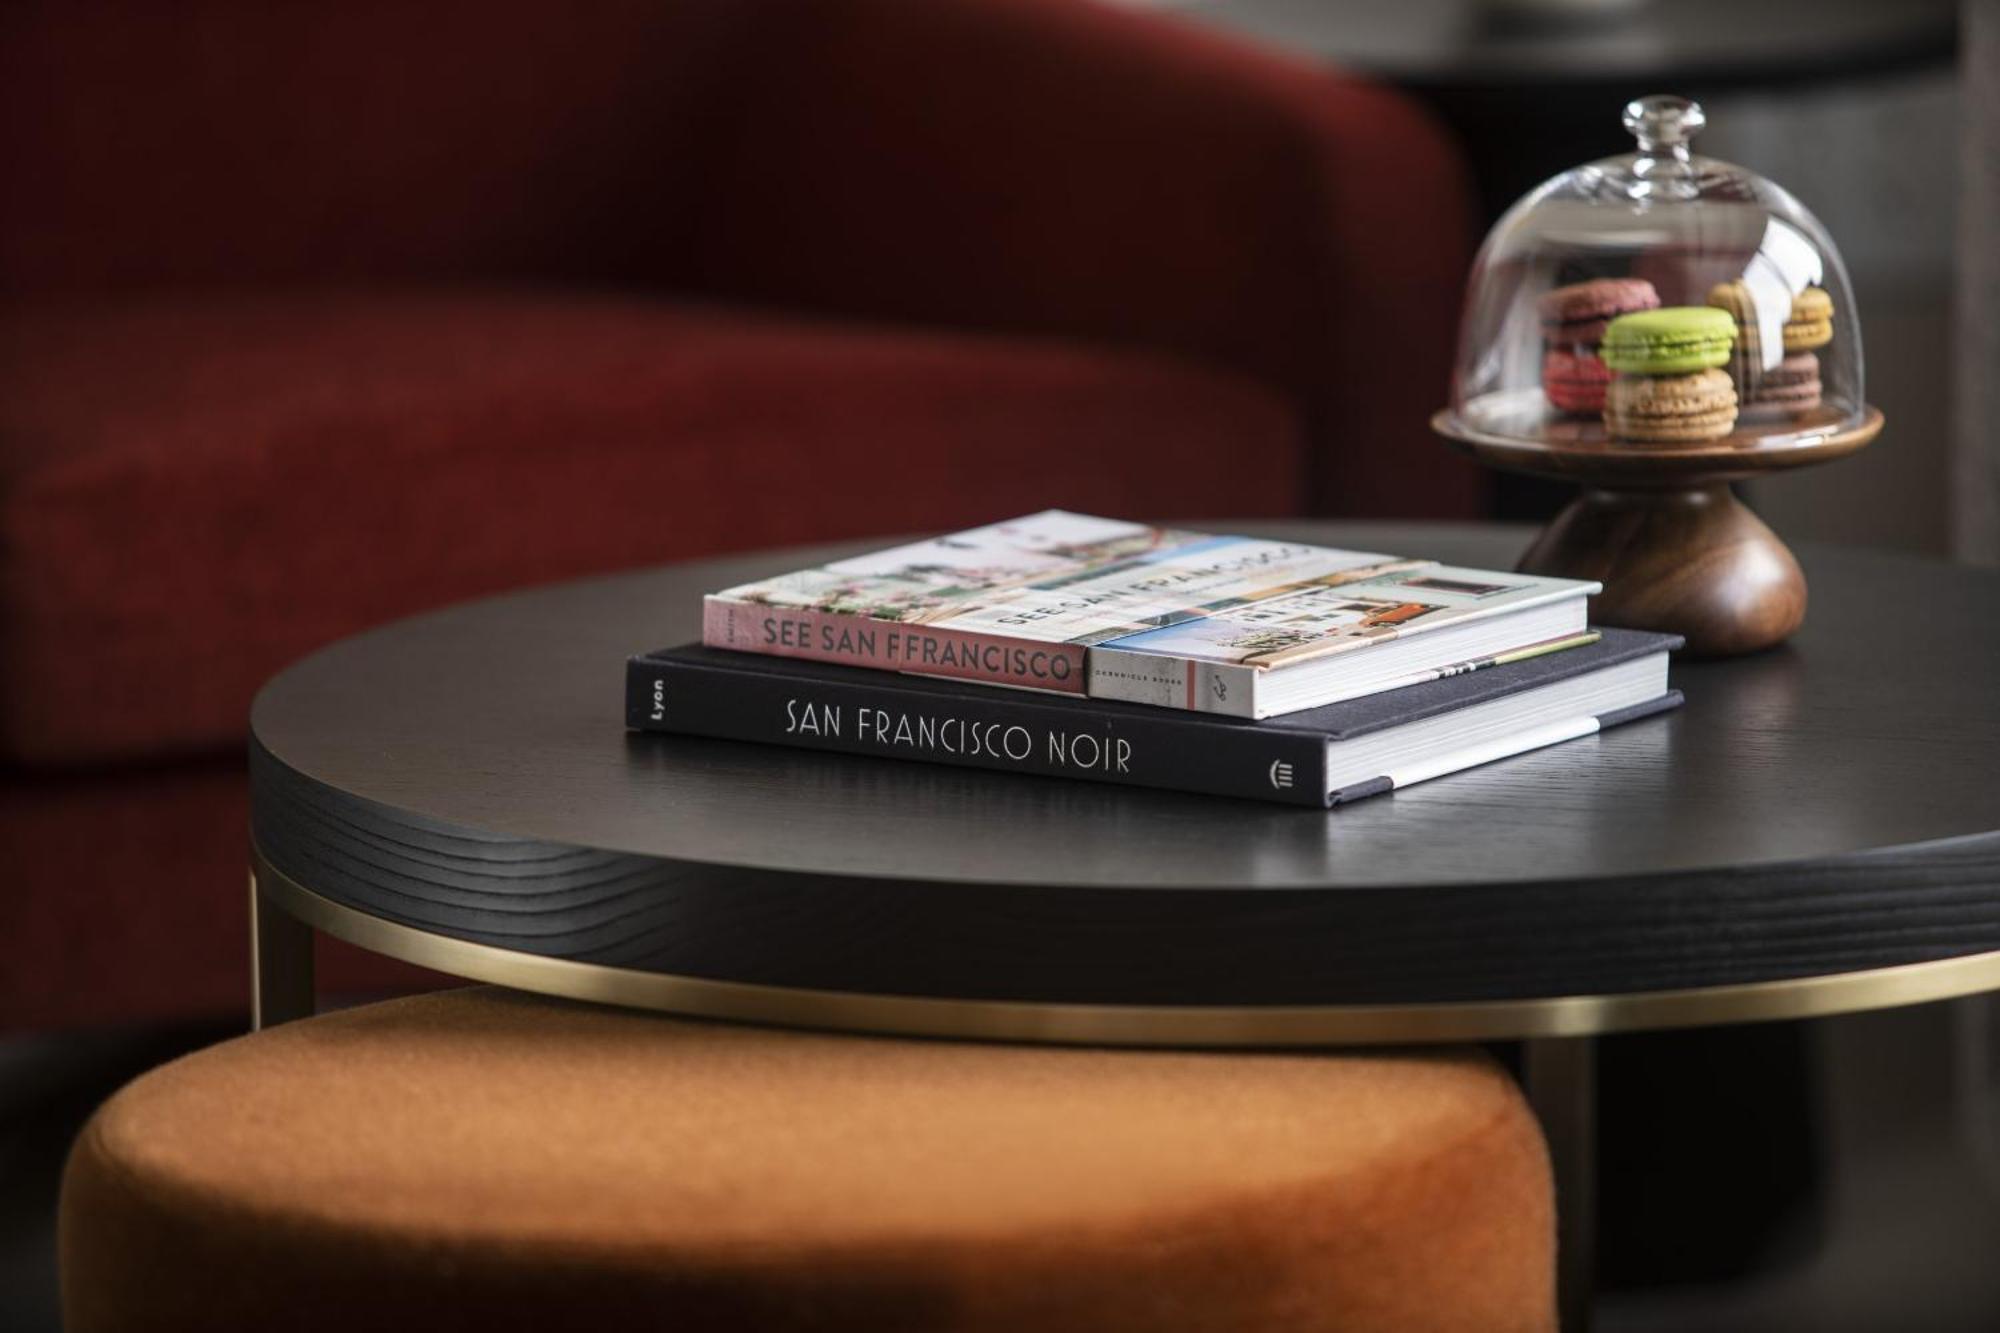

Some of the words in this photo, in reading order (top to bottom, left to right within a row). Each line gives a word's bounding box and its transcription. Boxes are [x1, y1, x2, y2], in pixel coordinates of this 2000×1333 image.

[995, 606, 1066, 625] SEE
[763, 617, 812, 649] SEE
[822, 624, 877, 657] SAN
[650, 679, 665, 721] Lyon
[785, 699, 841, 737] SAN
[858, 707, 1032, 760] FRANCISCO
[1049, 730, 1132, 774] NOIR
